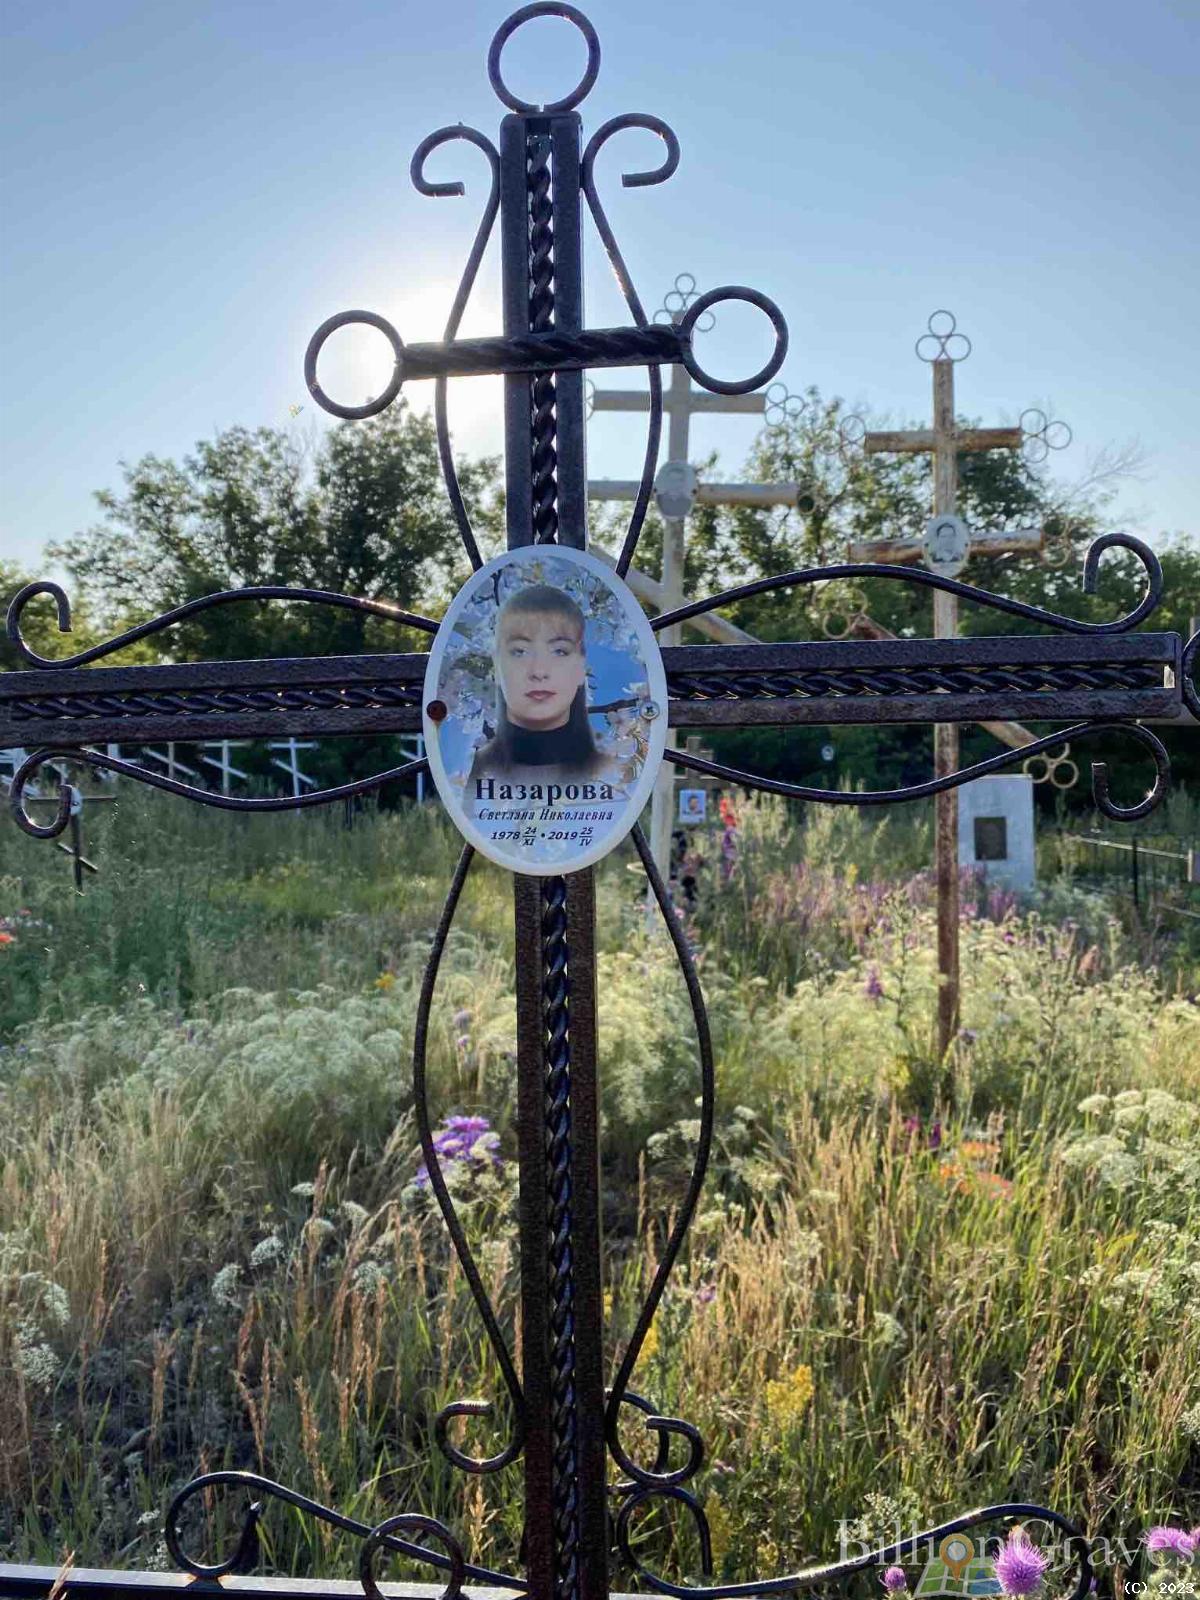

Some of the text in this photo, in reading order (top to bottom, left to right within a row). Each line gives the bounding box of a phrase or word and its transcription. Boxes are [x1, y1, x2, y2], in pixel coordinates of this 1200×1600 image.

[475, 778, 614, 806] Назарова
[478, 808, 613, 821] Светлана Николаевна
[490, 831, 520, 840] 1978
[548, 832, 578, 840] 2019
